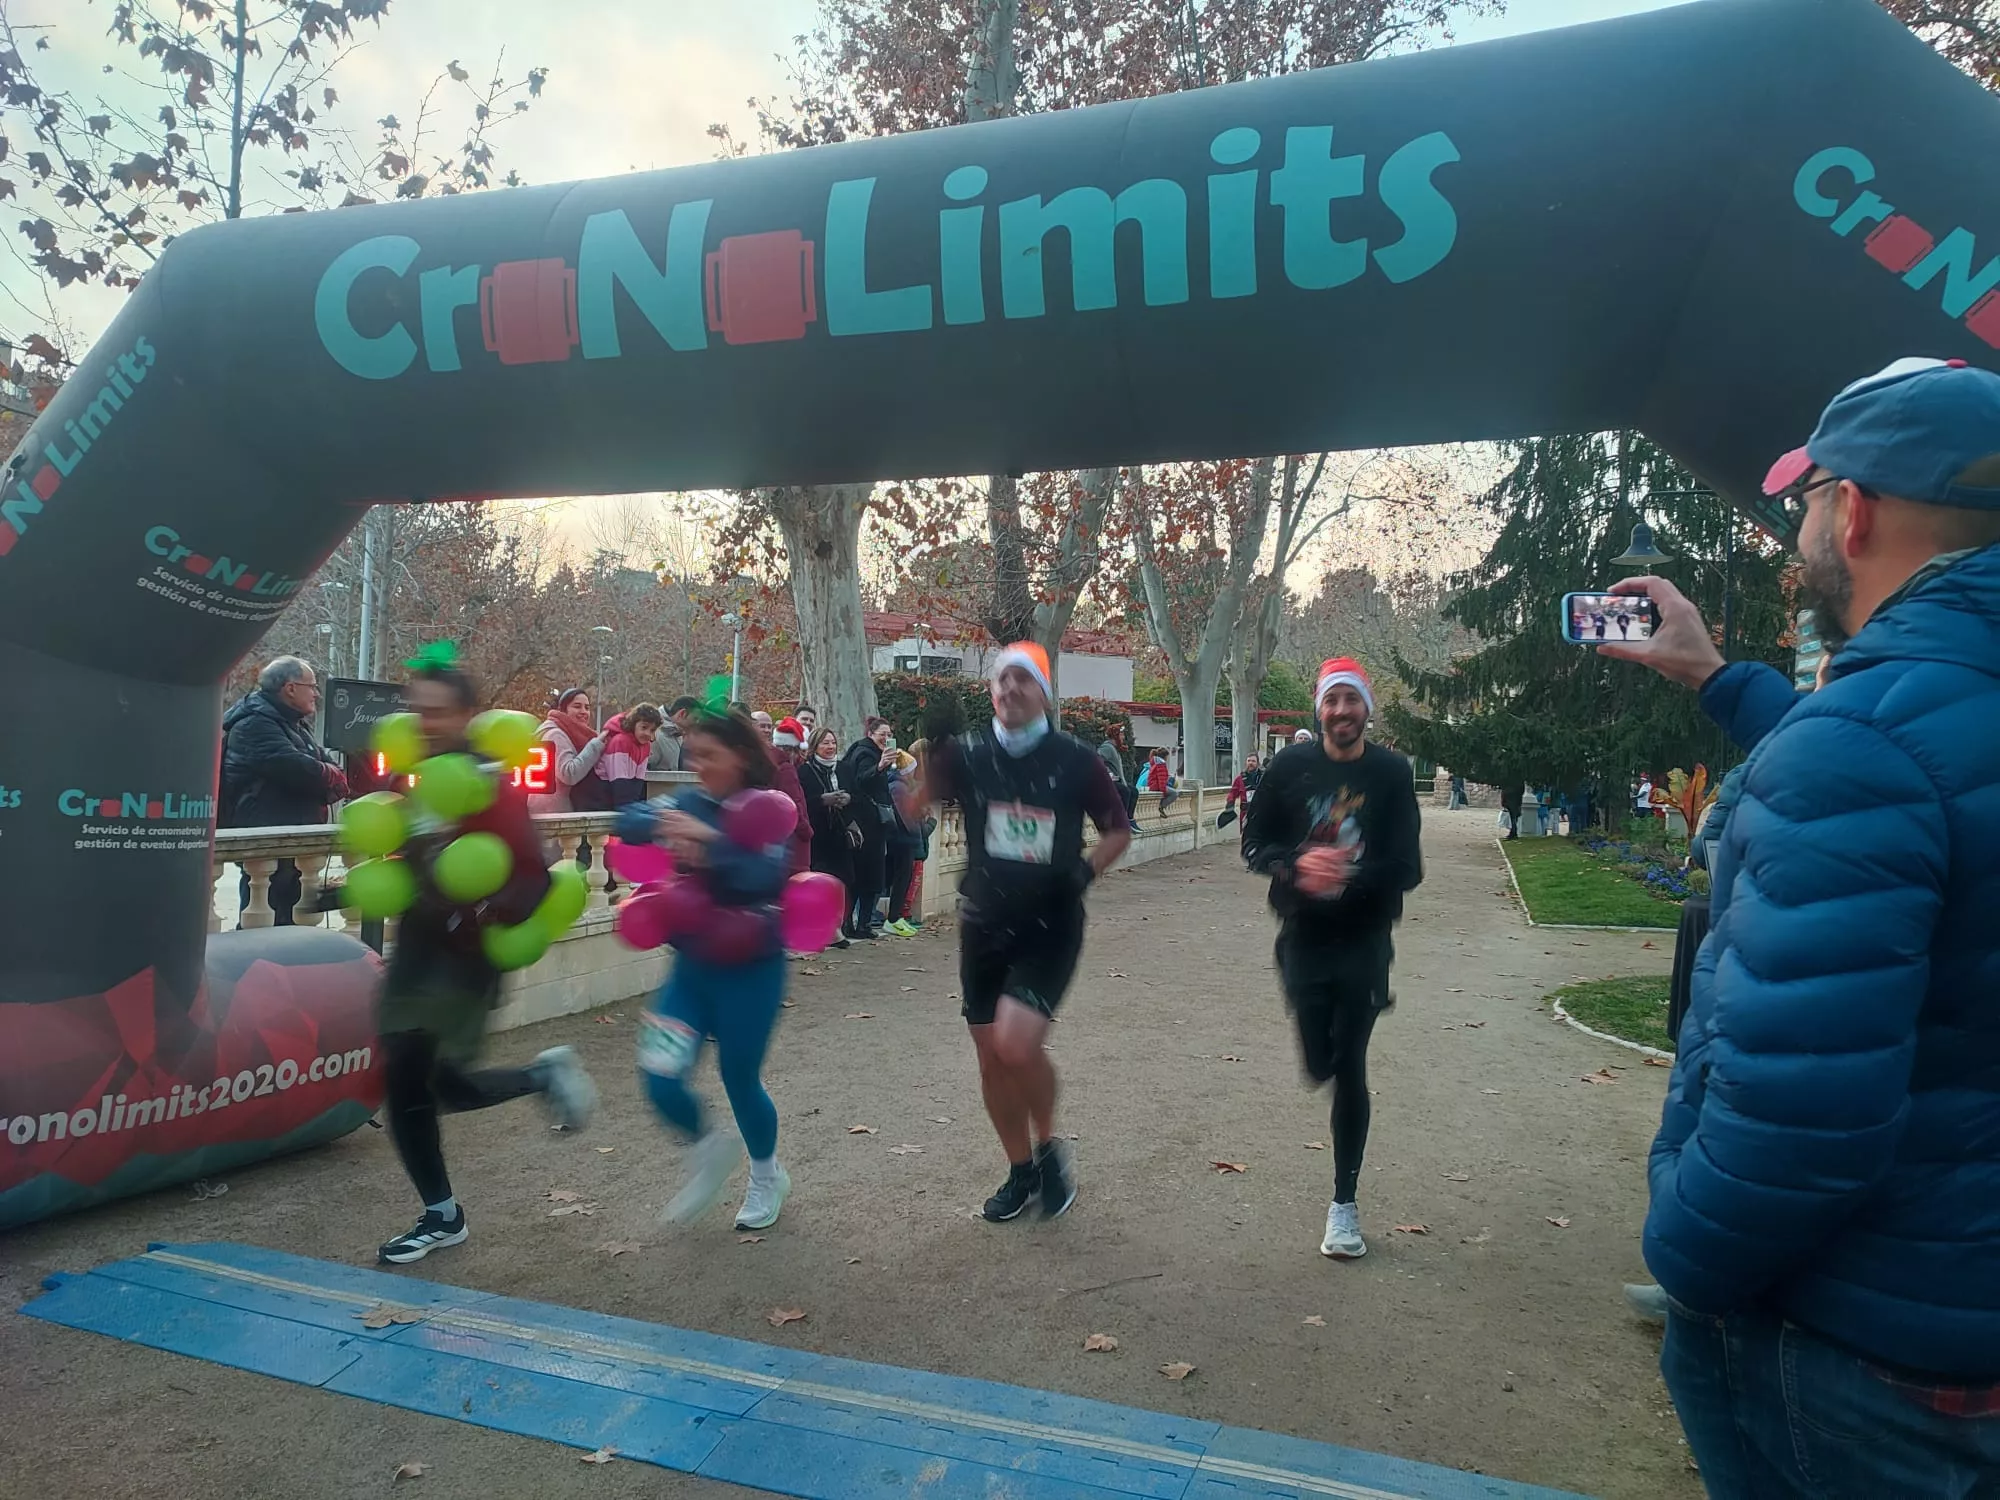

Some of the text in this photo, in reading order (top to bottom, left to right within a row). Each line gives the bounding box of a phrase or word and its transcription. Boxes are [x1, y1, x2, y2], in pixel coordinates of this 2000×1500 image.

[137, 577, 188, 604] gestión
[189, 599, 207, 611] de
[153, 566, 205, 595] Servicio
[206, 590, 224, 602] de
[82, 823, 129, 836] Servicio
[131, 825, 146, 836] de
[74, 838, 121, 850] gestión
[123, 839, 138, 849] de
[140, 840, 176, 850] eventos
